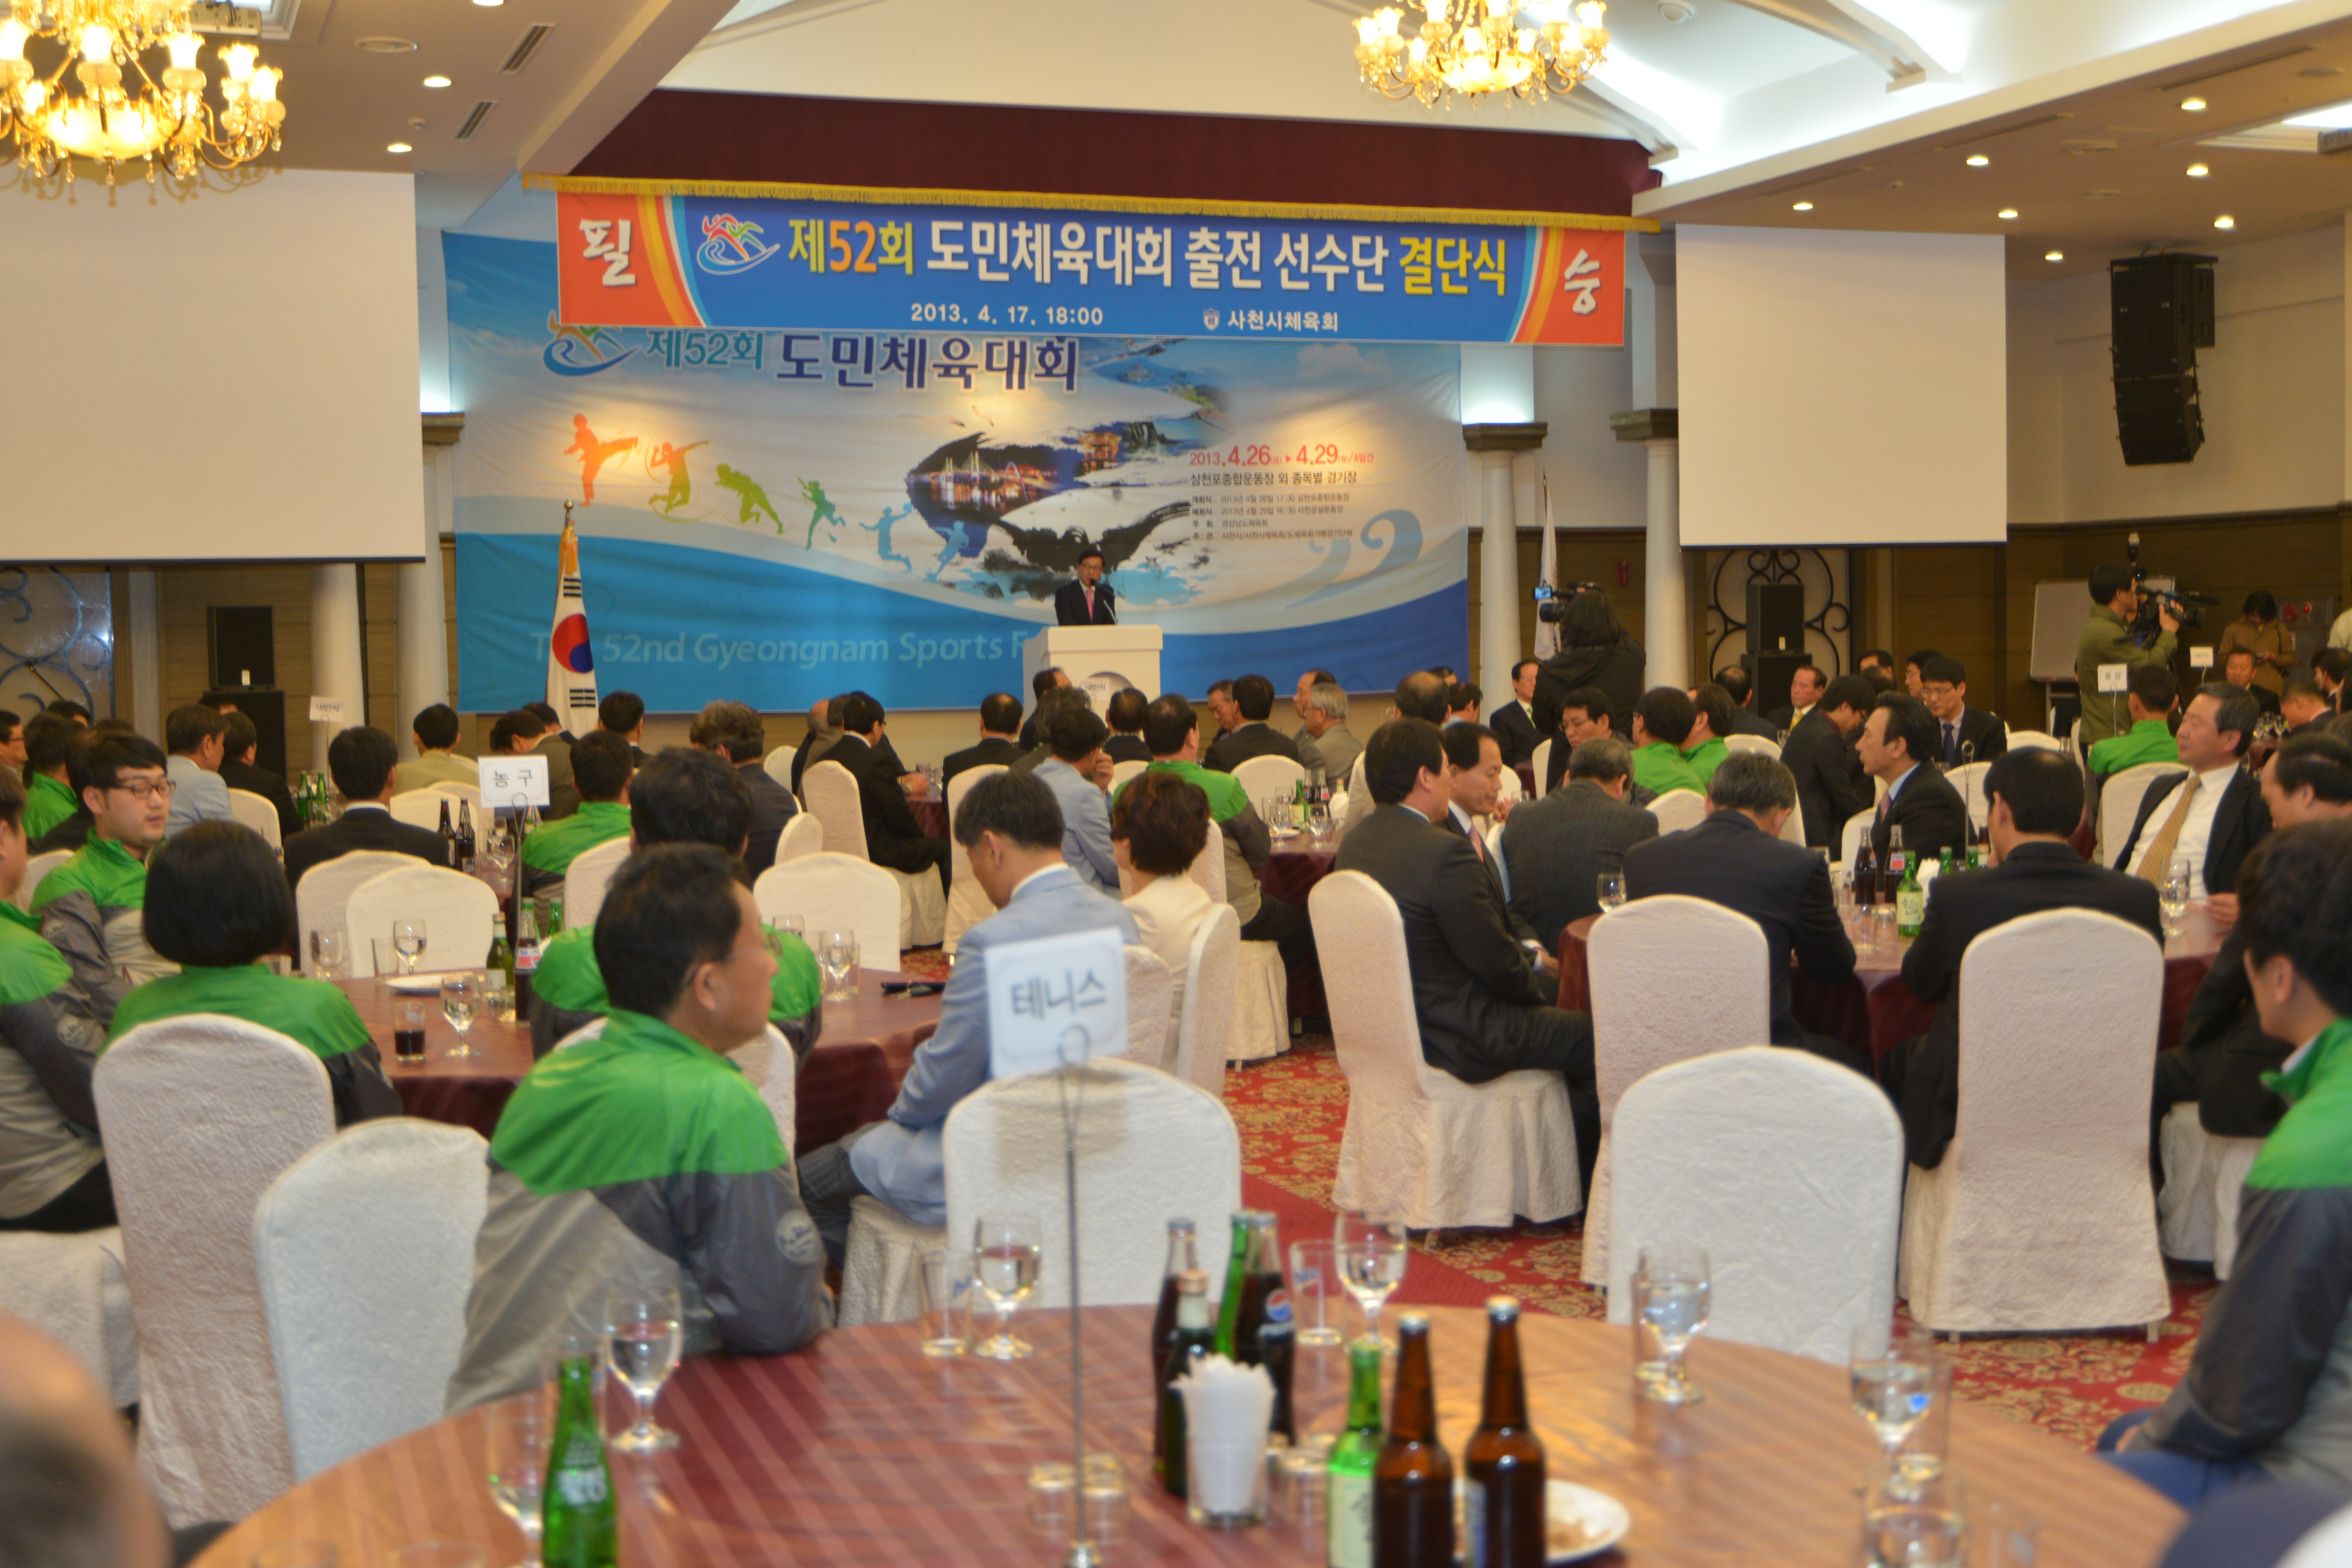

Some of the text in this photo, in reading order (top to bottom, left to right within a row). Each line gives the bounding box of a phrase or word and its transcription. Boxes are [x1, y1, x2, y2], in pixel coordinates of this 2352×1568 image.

[579, 219, 636, 286] 필
[789, 219, 1506, 295] 제52회 도민체육대회 출전 선수단 결단식
[1564, 248, 1601, 315] 승
[911, 303, 1103, 326] 2013. 4. 17. 18:00
[1227, 308, 1338, 332] 사천시체육회
[646, 330, 1076, 391] 제52회 도민체육대회
[1190, 470, 1357, 486] 삼천포종합운동장 외 종목별 경기장
[602, 631, 686, 663] 52nd
[694, 633, 889, 670] Gyeongnam
[899, 631, 1003, 669] Sports
[1010, 968, 1107, 1021] 테니스
